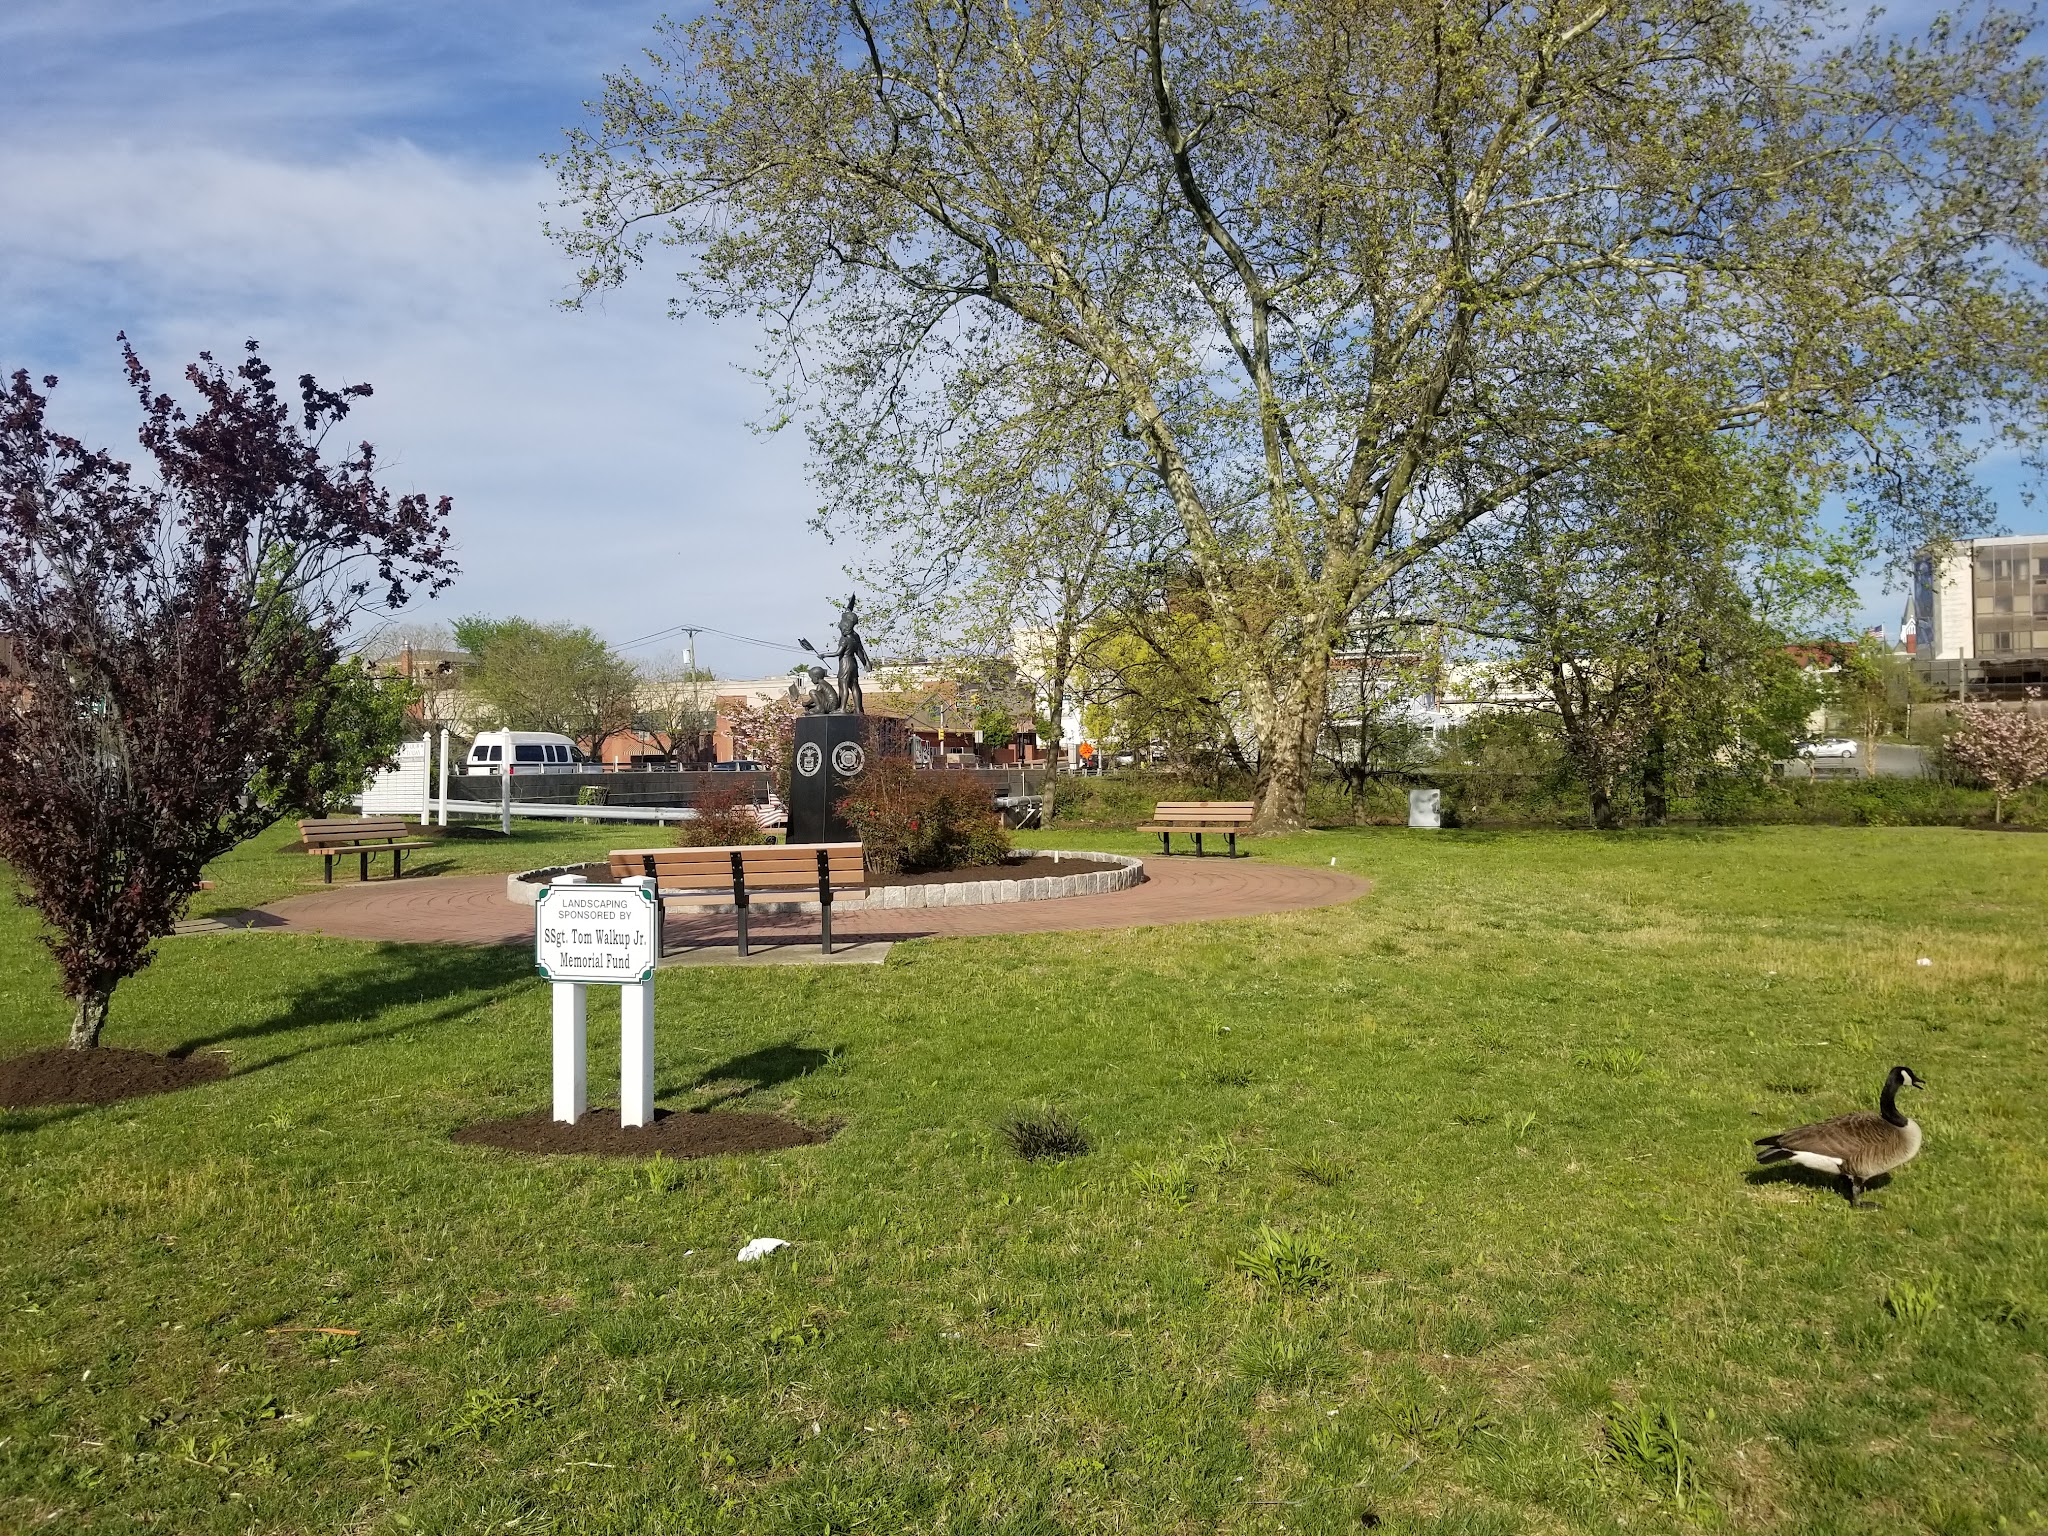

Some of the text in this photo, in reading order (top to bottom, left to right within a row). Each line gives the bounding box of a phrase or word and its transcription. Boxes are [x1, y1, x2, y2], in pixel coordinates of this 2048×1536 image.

[562, 899, 628, 908] LANDSCAPING
[558, 910, 632, 920] SPONSORED BY
[544, 928, 647, 949] SSgt. Tom Walkup Jr.
[560, 952, 630, 969] Memorial Fund
